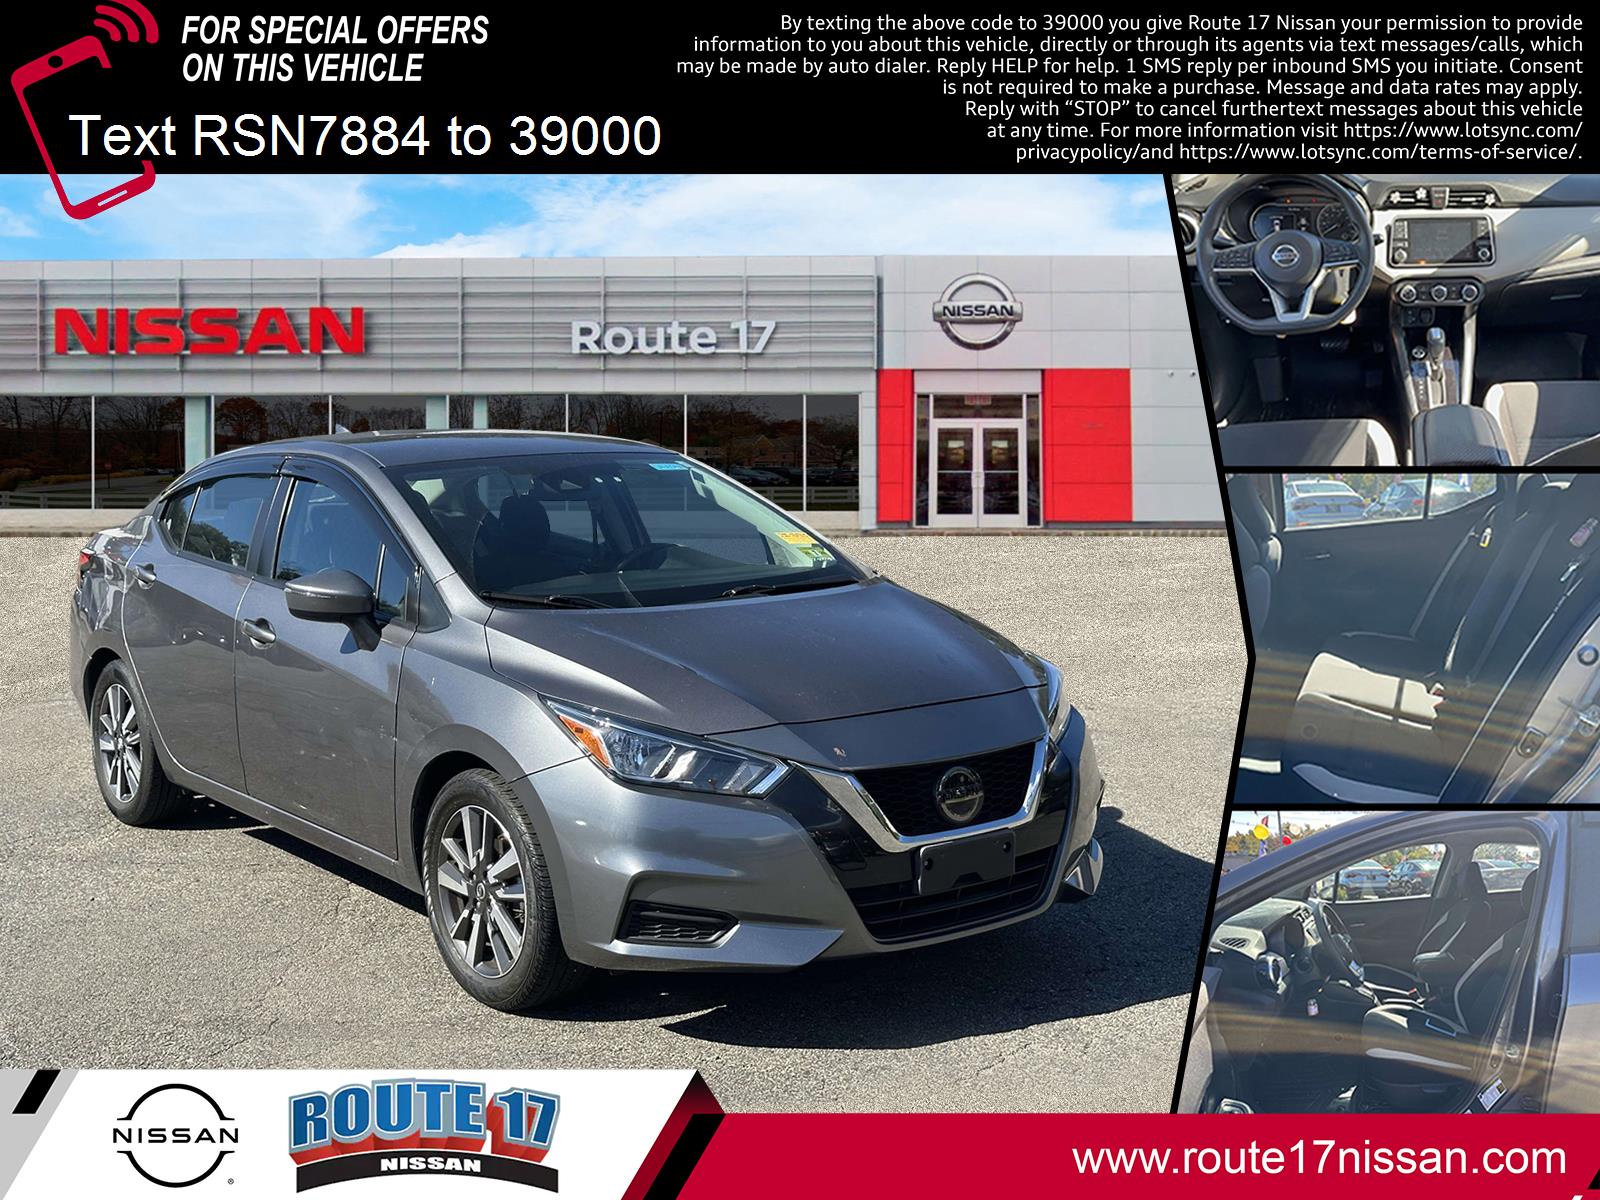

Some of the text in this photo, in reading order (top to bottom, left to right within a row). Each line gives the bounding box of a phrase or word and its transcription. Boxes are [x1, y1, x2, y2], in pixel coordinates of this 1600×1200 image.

[943, 305, 1014, 317] NISSAN
[54, 307, 365, 354] NISSAN
[571, 319, 776, 354] Route 17
